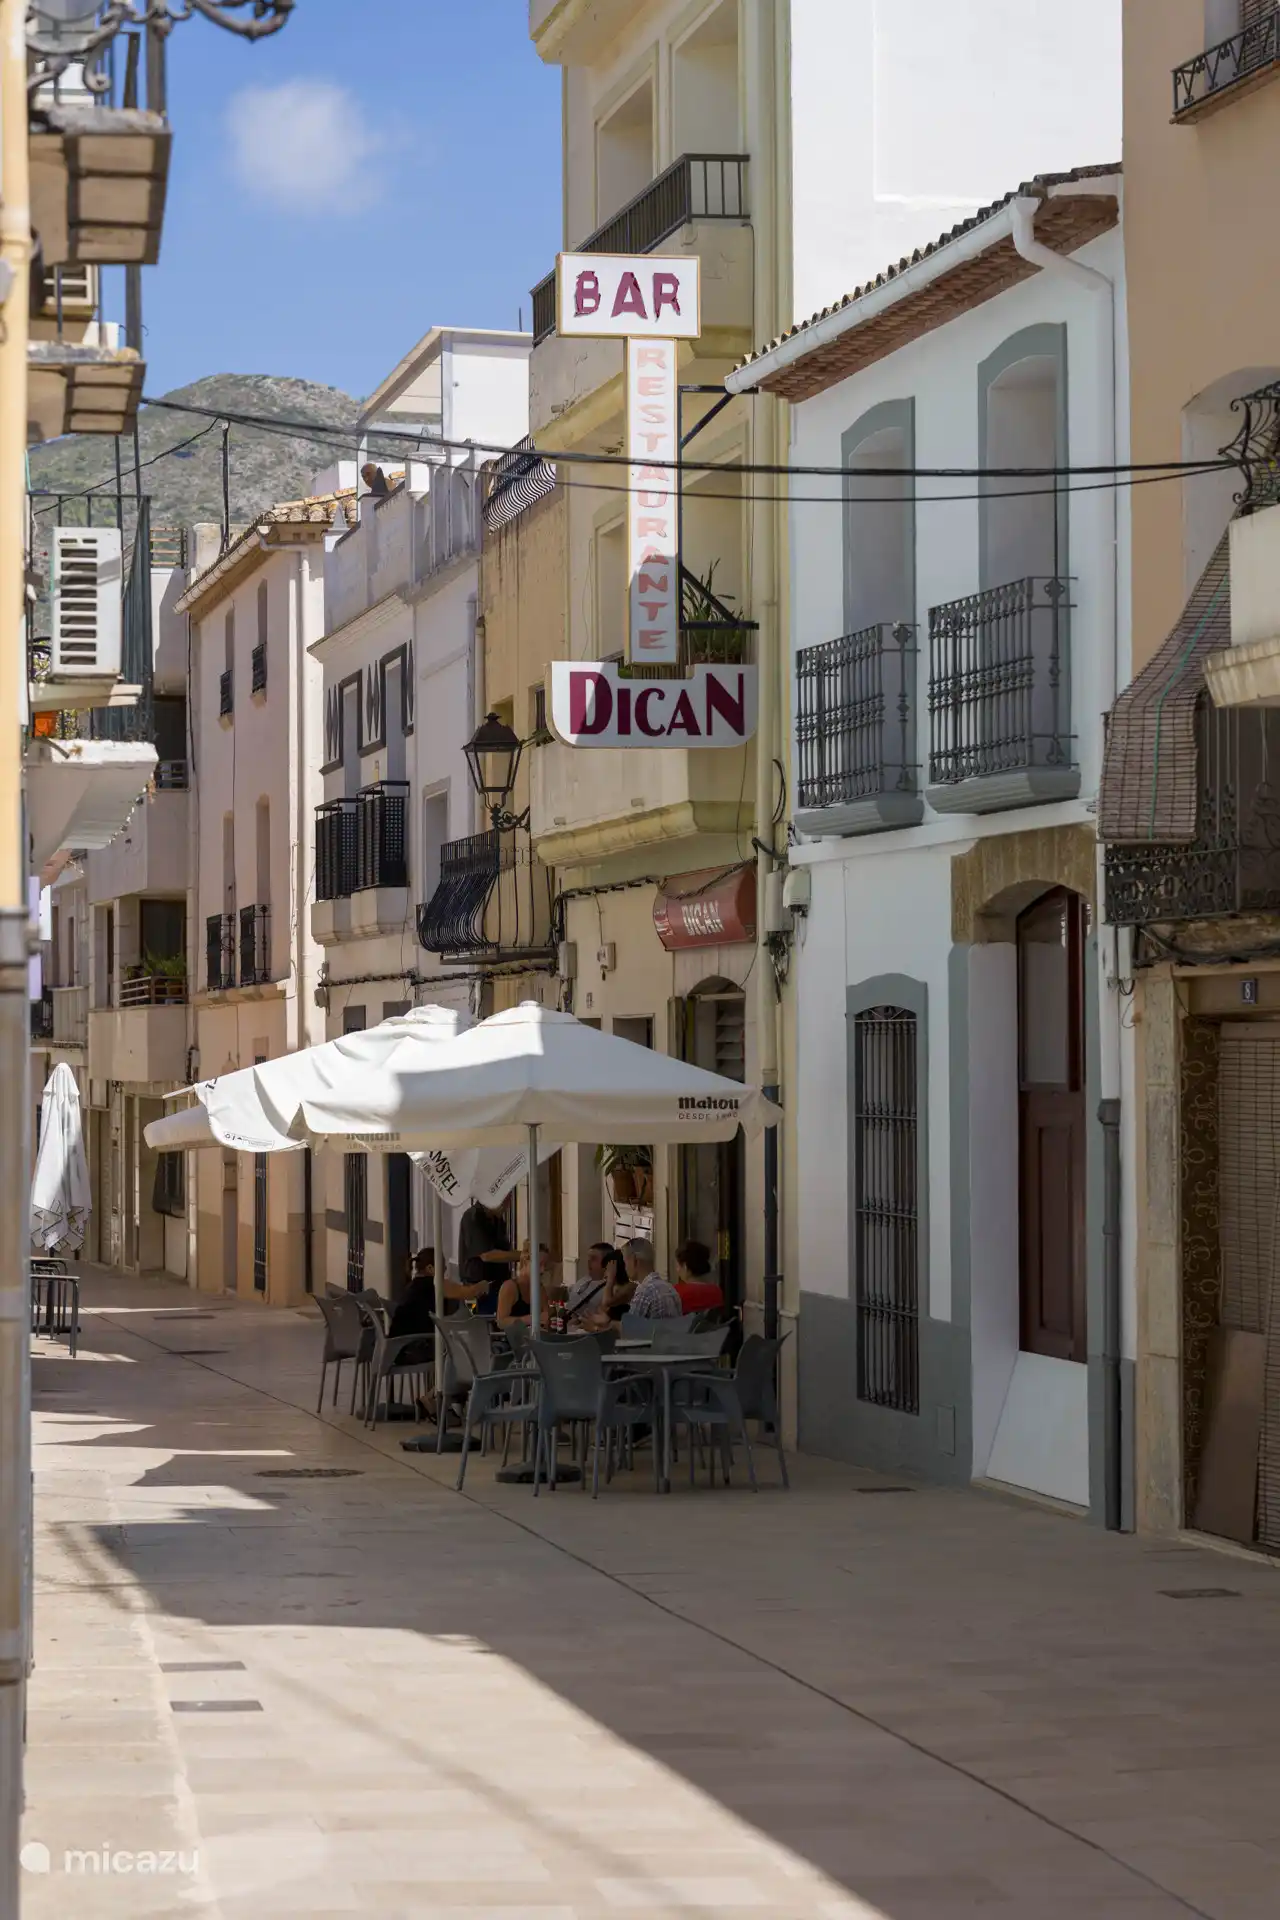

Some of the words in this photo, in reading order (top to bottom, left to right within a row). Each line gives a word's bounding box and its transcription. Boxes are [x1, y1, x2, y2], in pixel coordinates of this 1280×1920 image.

[574, 270, 681, 323] BAR
[636, 347, 669, 651] RESTAURANTE
[569, 671, 746, 737] DICAN
[681, 899, 725, 937] DICAN
[1244, 982, 1251, 1000] 8
